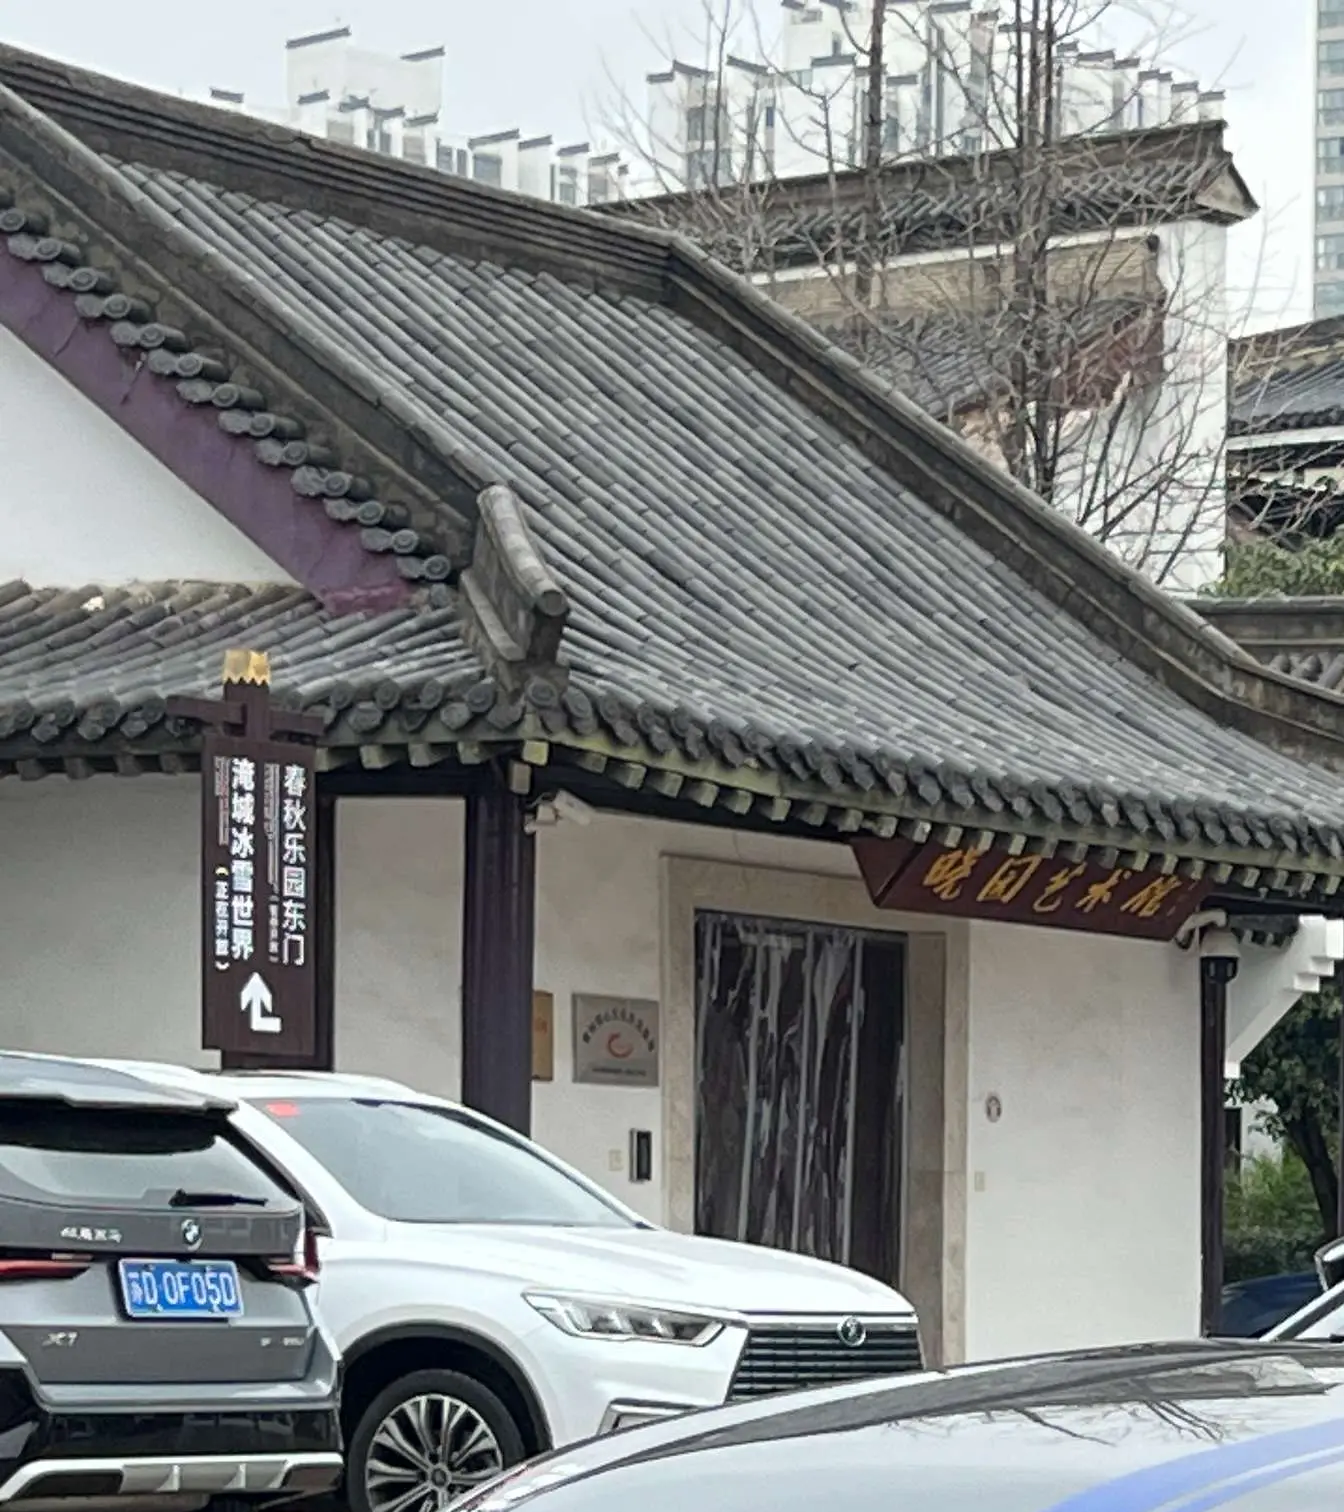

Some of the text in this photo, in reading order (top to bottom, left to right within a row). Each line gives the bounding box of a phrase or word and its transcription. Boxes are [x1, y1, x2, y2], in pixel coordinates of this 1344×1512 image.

[282, 764, 307, 966] 春秋乐园东门
